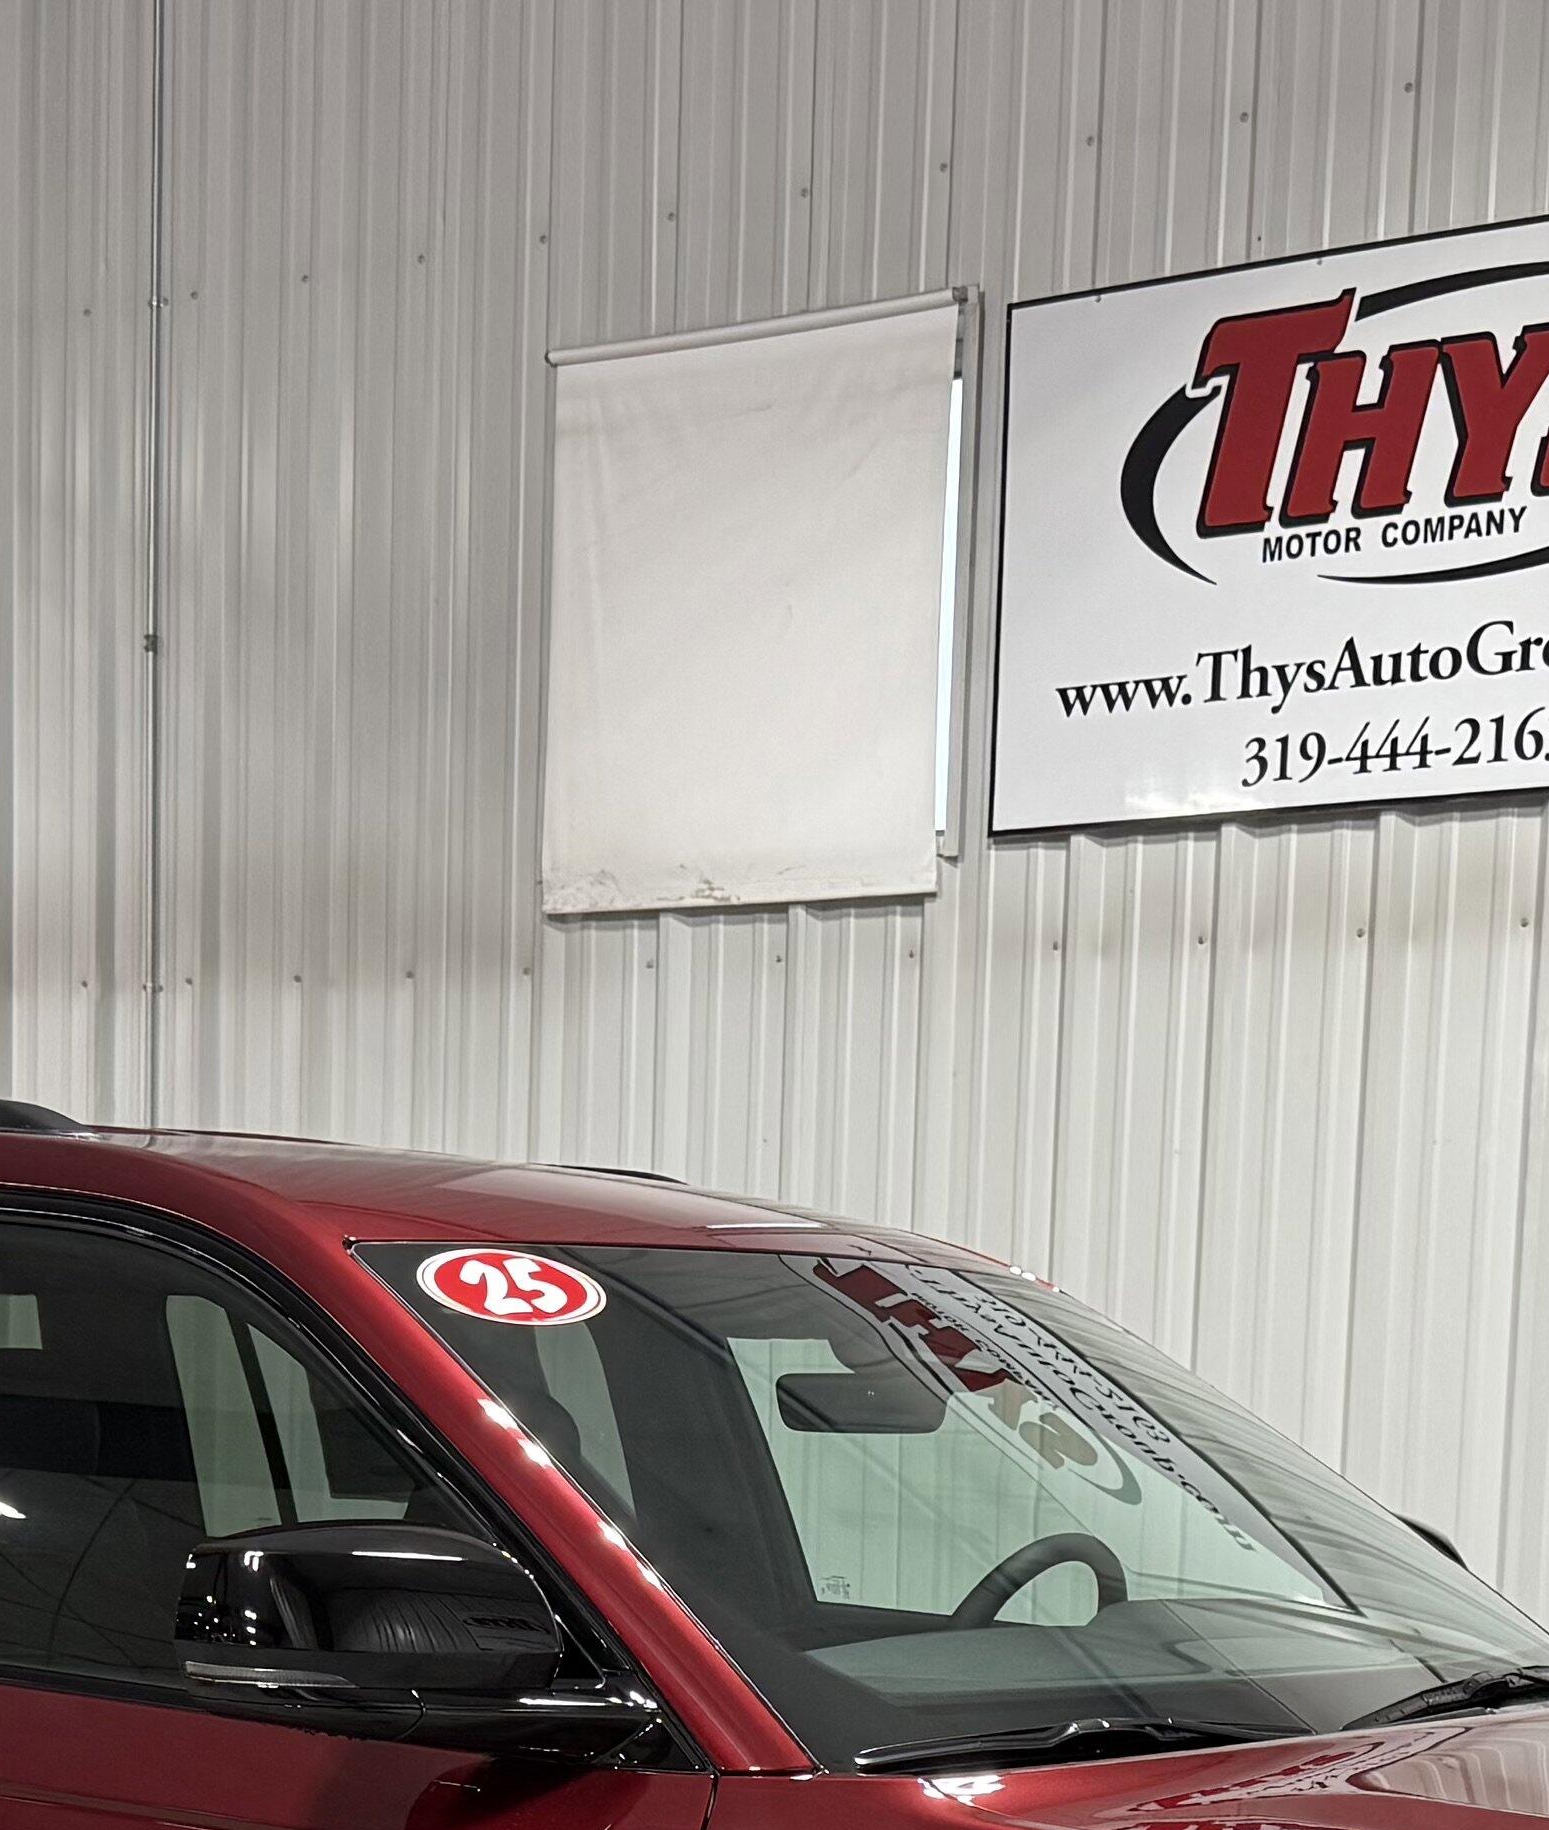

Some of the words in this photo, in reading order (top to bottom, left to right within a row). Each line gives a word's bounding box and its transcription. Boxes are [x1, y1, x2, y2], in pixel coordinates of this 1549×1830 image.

[1261, 526, 1362, 564] MOTOR
[1381, 506, 1528, 549] COMPANY
[459, 1258, 568, 1316] 25
